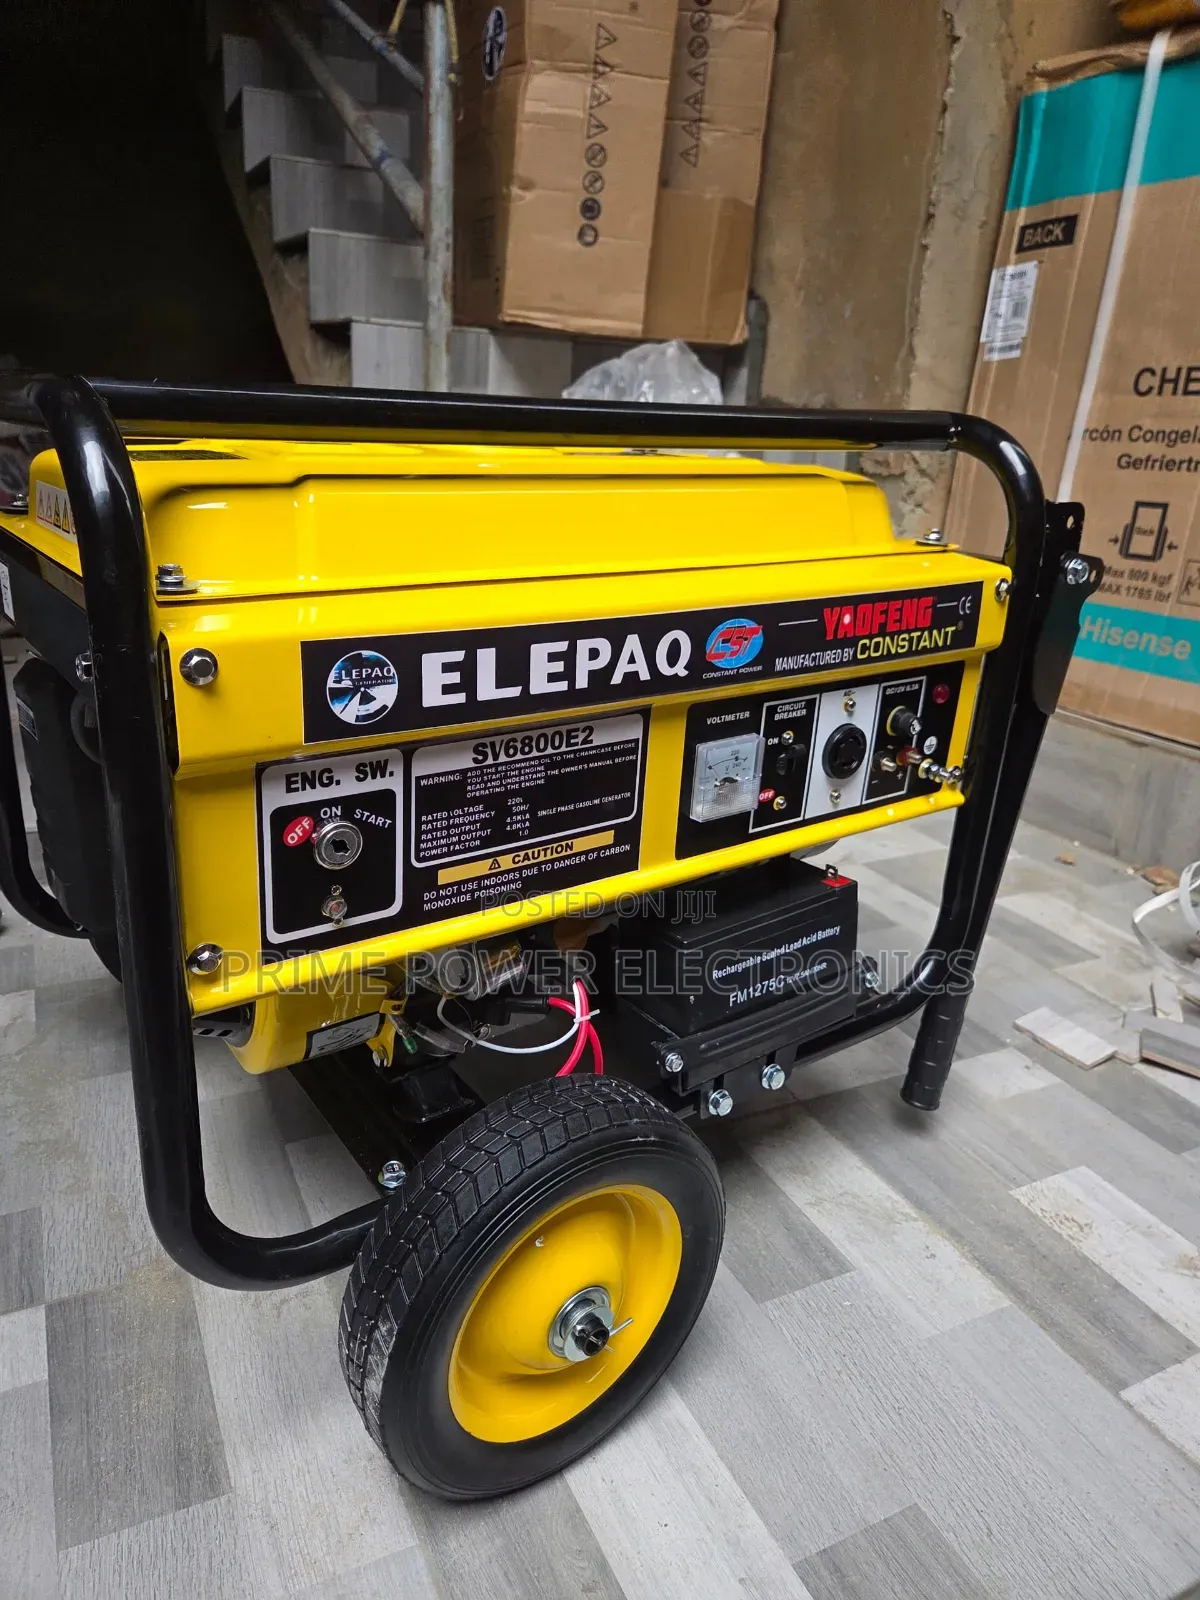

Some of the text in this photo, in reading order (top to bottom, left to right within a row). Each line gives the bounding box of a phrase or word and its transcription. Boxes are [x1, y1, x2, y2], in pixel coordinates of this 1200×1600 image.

[1023, 221, 1067, 247] BACK
[1133, 366, 1200, 397] CHE
[1068, 424, 1122, 441] rcón
[1151, 572, 1173, 588] kgf
[958, 595, 972, 615] CE
[823, 596, 934, 641] YAOFENG
[705, 625, 763, 663] CST
[1080, 615, 1191, 660] Hisense
[775, 626, 957, 672] MANUFACTURED BY CONSTANT
[333, 667, 394, 680] ELEPAQ
[421, 629, 692, 708] ELEPAQ
[702, 665, 763, 679] CONSTANT POWER
[774, 709, 807, 721] BREAKER
[777, 701, 806, 713] CIRCUIT
[706, 710, 750, 725] VOLTMETER
[472, 725, 595, 765] SV6800E2
[767, 737, 779, 746] ON
[498, 760, 539, 771] RECOMMEND
[613, 742, 635, 751] BEFORE
[285, 758, 394, 794] ENG. SW.
[420, 773, 463, 787] WARNING:
[467, 783, 485, 791] READ
[502, 772, 545, 785] UNDERSTAND
[561, 763, 588, 774] OWNER'S
[589, 759, 613, 768] MANUAL
[614, 754, 636, 763] BEFORE
[483, 773, 505, 781] START
[521, 765, 545, 774] ENGINE
[521, 779, 545, 788] ENGINE
[537, 792, 631, 817] SINGLE PHASE GASOLINE GENERATOR
[759, 790, 775, 800] OFF
[320, 805, 341, 819] ON
[353, 808, 392, 829] START
[421, 811, 448, 822] RATED
[421, 811, 495, 831] RATED FREQUENCY
[287, 817, 313, 845] OFF
[420, 829, 492, 849] MAXIMUM OUTPUT
[421, 823, 481, 841] RATED OUTPUT
[420, 840, 480, 858] POWER FACTOR
[511, 841, 574, 865] CAUTION
[423, 844, 631, 901] DO NOT USE INDOORS DUE TO DANGER OF CARBON
[423, 881, 522, 911] MONOXIDE POISONING
[712, 925, 841, 980] Rechargeable Sealed Lead Acid Battery
[730, 974, 784, 1007] FM1275C
